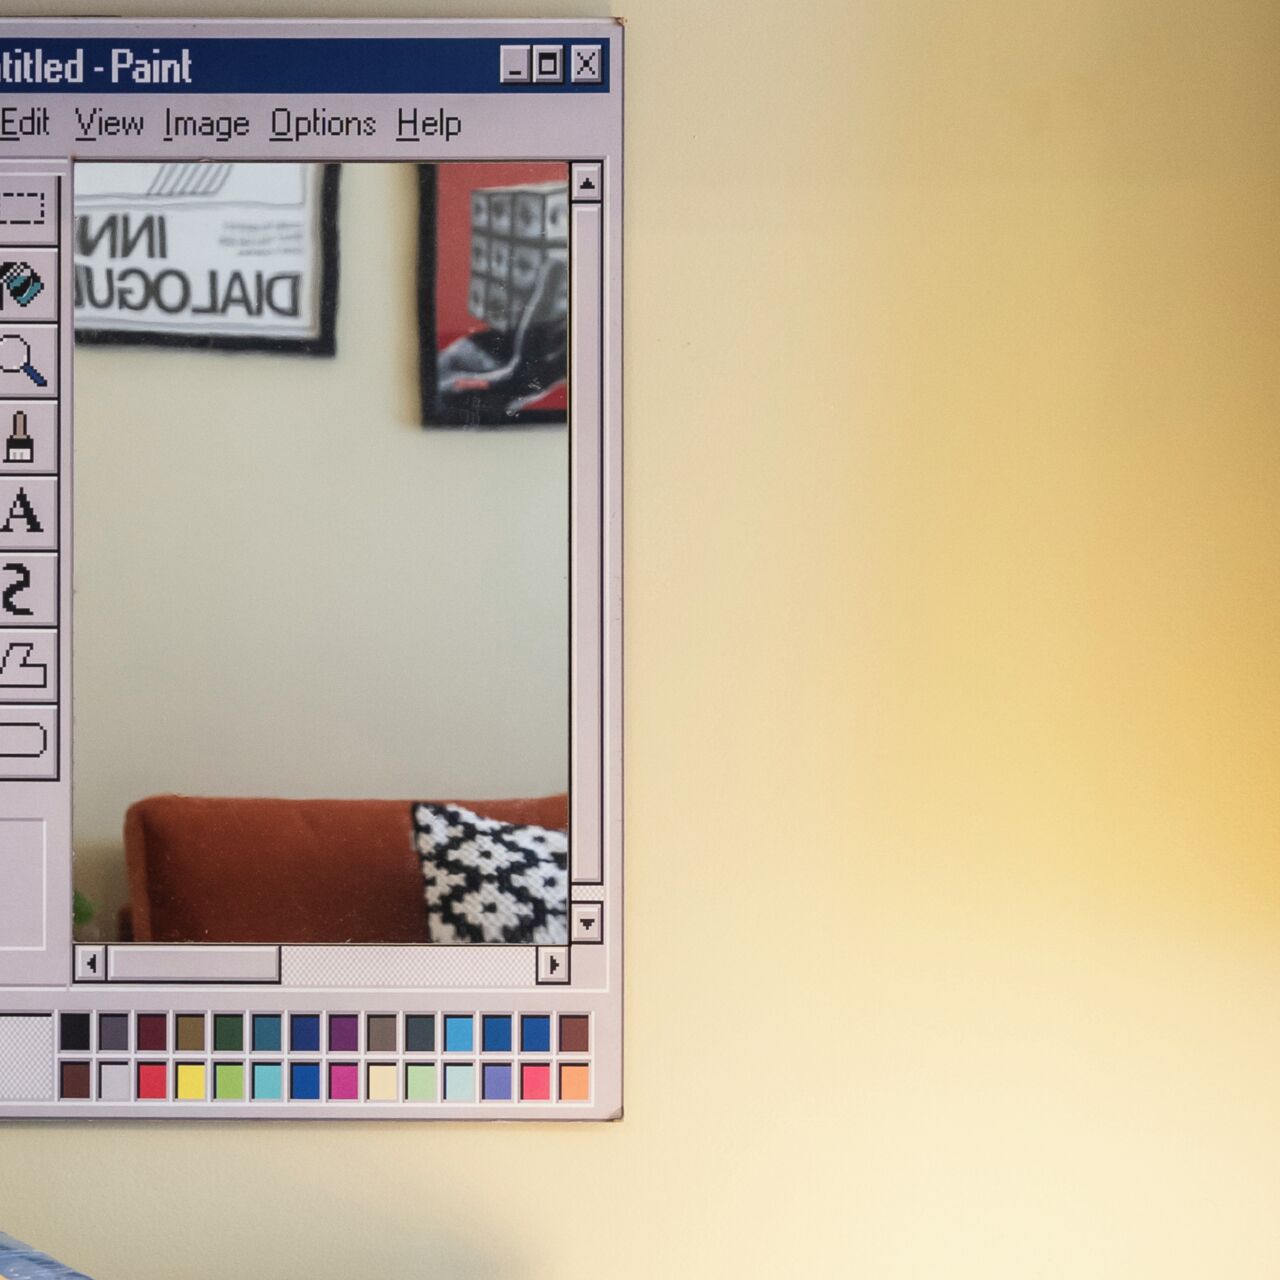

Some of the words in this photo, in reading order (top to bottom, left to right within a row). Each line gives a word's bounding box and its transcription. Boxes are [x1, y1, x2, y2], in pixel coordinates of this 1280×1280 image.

[111, 49, 193, 83] Paint
[0, 108, 50, 140] Edit
[75, 108, 145, 140] View
[163, 108, 250, 141] Image
[270, 108, 378, 141] Options
[397, 108, 462, 141] Help
